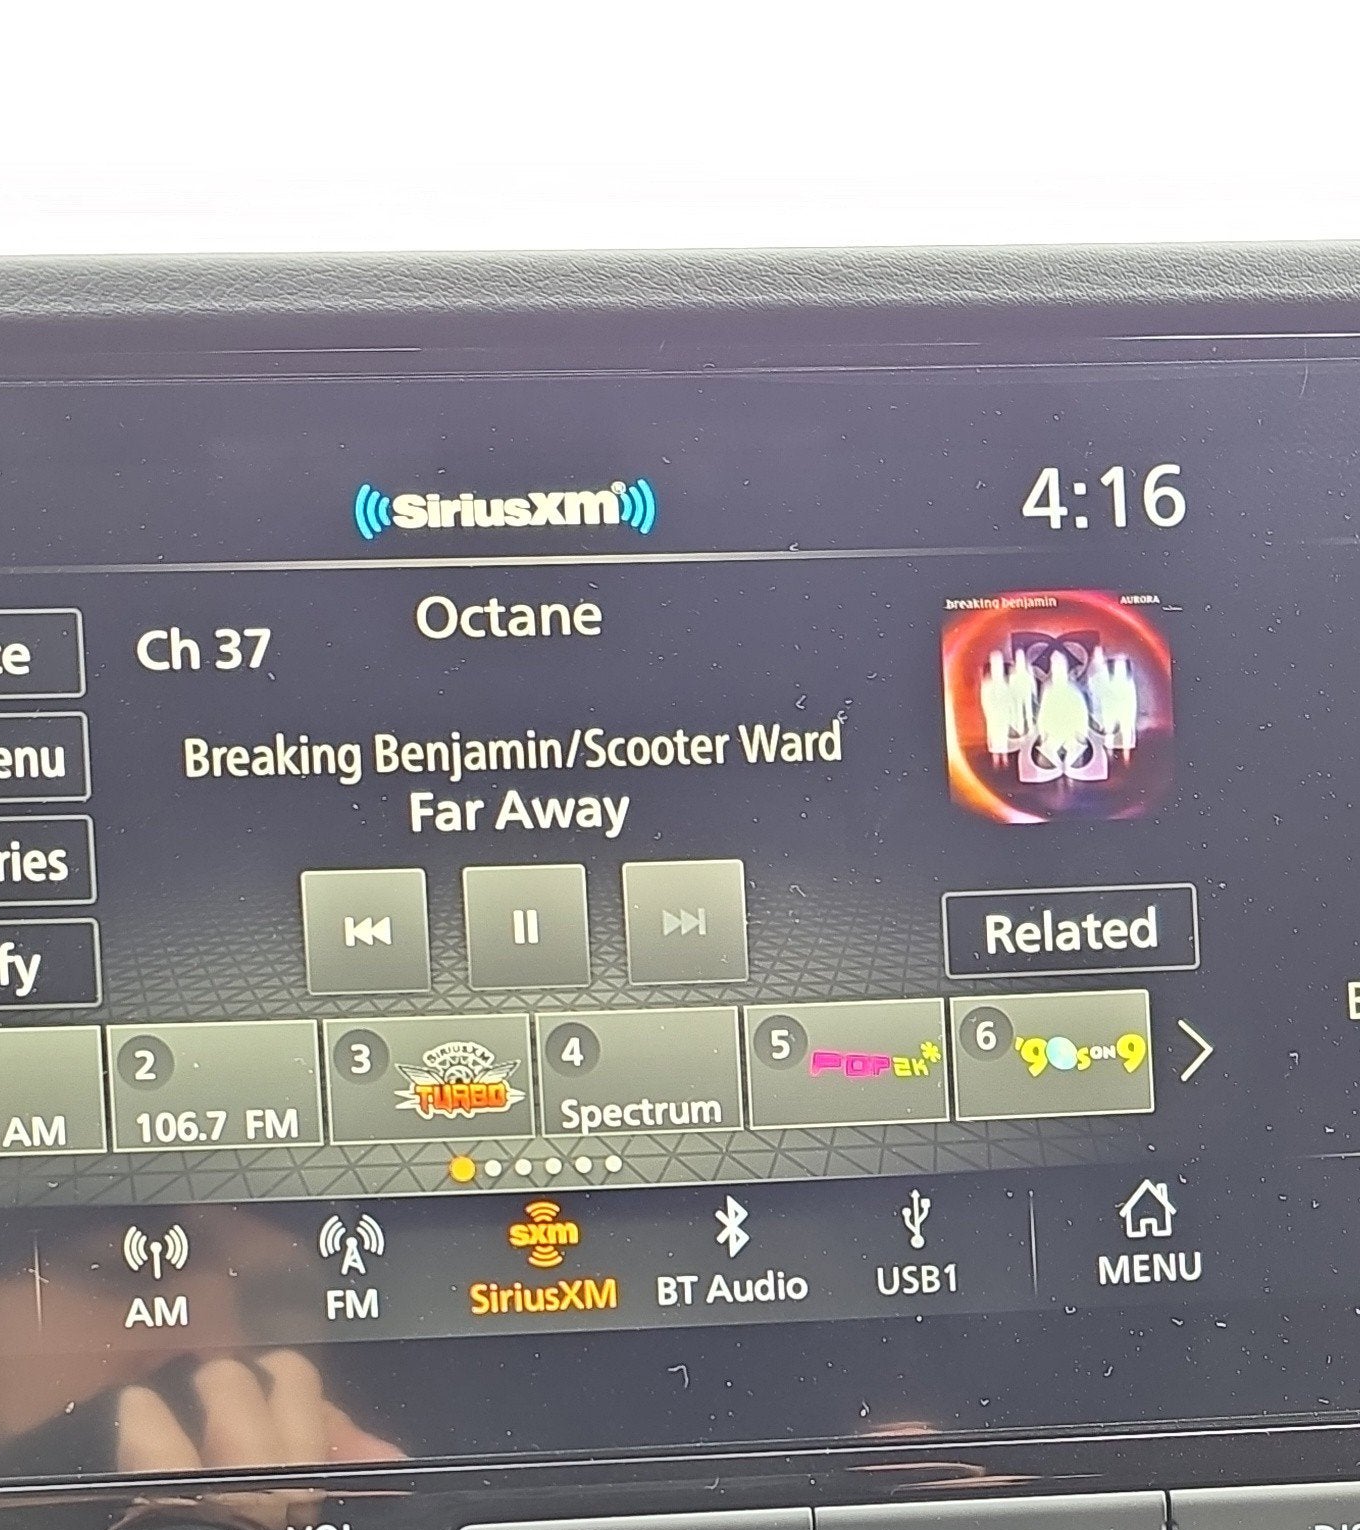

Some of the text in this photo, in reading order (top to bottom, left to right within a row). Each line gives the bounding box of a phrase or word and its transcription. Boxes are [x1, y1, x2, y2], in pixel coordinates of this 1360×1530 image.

[1022, 464, 1186, 529] 4:16
[1001, 597, 1058, 611] benjamin
[1120, 595, 1160, 605] AURORA
[416, 596, 602, 639] Octane
[137, 628, 271, 671] Ch 37
[184, 721, 842, 785] Breaking Benjamin/Scooter Ward
[410, 790, 630, 838] Far Away
[985, 906, 1158, 954] Related
[771, 1030, 790, 1059] 5
[976, 1020, 997, 1050] 6
[134, 1050, 157, 1081] 2
[351, 1044, 371, 1074] 3
[561, 1037, 583, 1067] 4
[415, 1083, 508, 1115] TURBO
[2, 1116, 67, 1148] AM
[136, 1109, 298, 1143] 106.7 FM
[560, 1098, 722, 1134] Spectrum
[876, 1264, 958, 1295] USB1
[1098, 1252, 1202, 1285] MENU
[471, 1279, 618, 1315] SiriusXM
[657, 1270, 809, 1306] BT Audio
[125, 1296, 189, 1328] AM
[326, 1289, 379, 1320] FM
